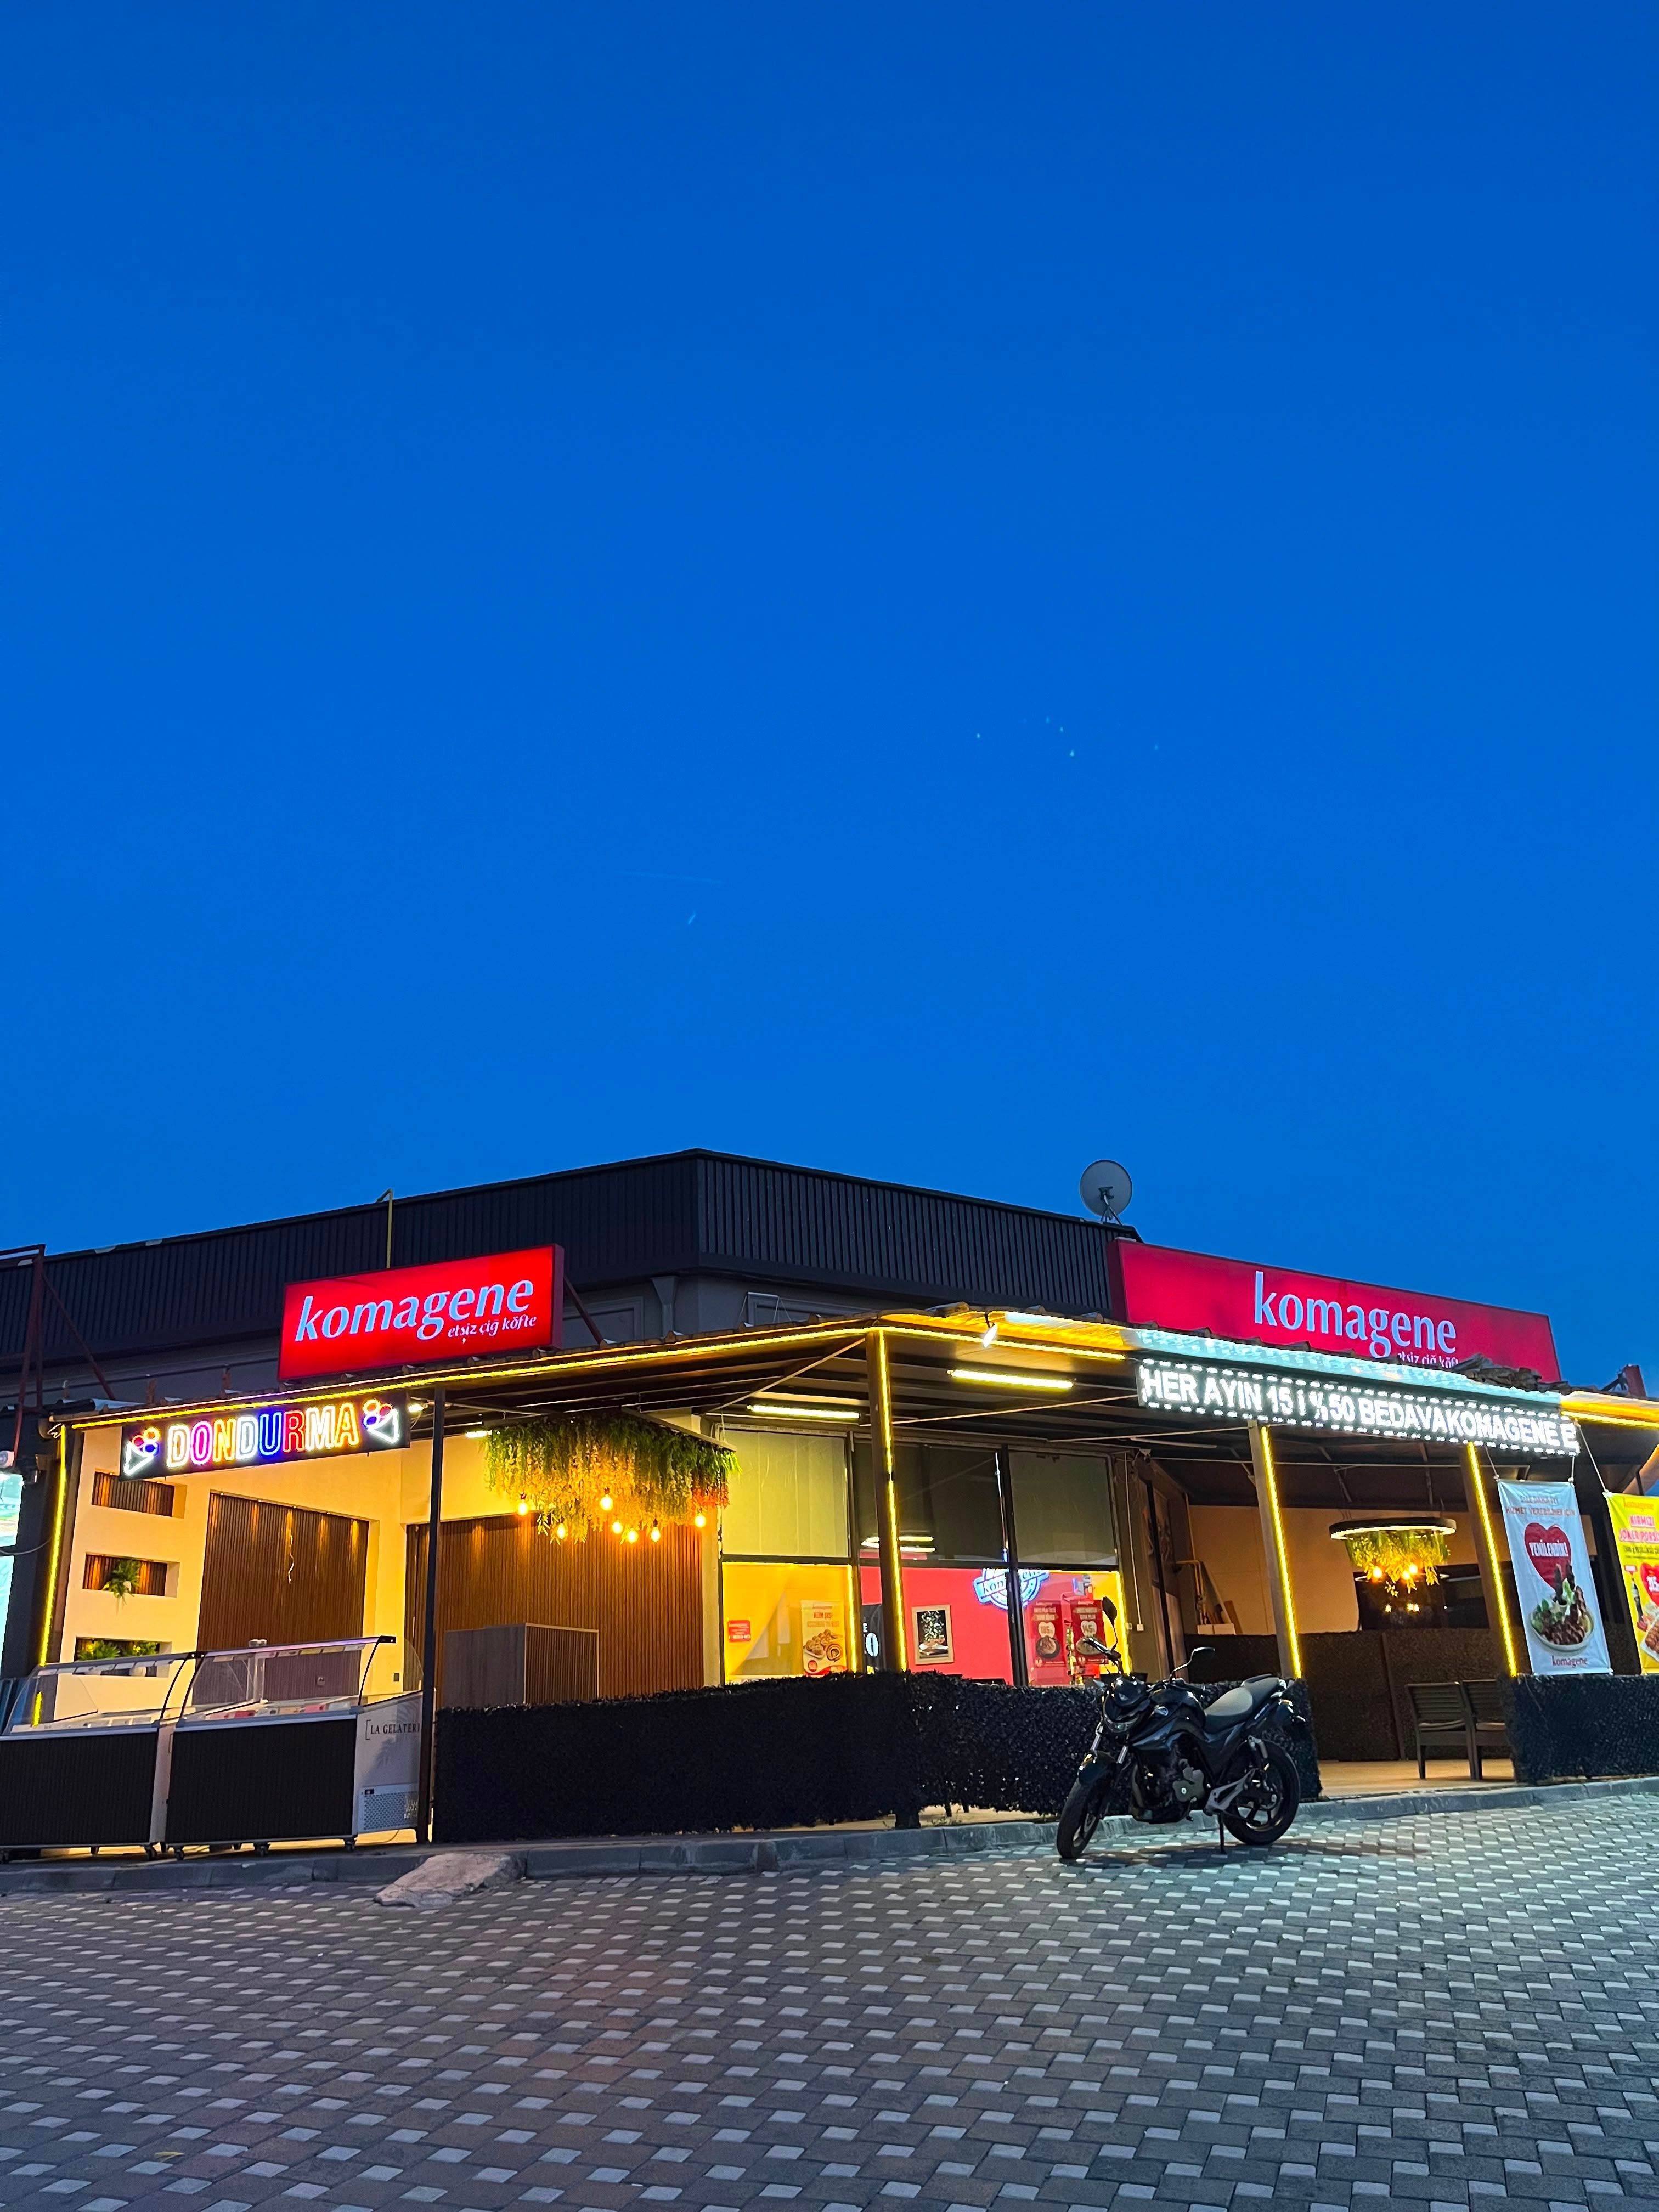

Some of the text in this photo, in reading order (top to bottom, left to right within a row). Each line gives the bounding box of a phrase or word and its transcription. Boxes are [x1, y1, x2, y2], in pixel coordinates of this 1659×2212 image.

[295, 1279, 534, 1340] komagene
[448, 1313, 537, 1338] etsiz çiğ köfte
[1254, 1270, 1457, 1359] komagene
[1144, 1368, 1199, 1403] HER
[1204, 1377, 1262, 1412] AYIN
[1267, 1385, 1294, 1415] 15
[1308, 1391, 1356, 1423] %50
[167, 1402, 360, 1468] DONDURMA
[1551, 1655, 1588, 1668] komagene
[370, 1723, 420, 1735] LA GELATERI
